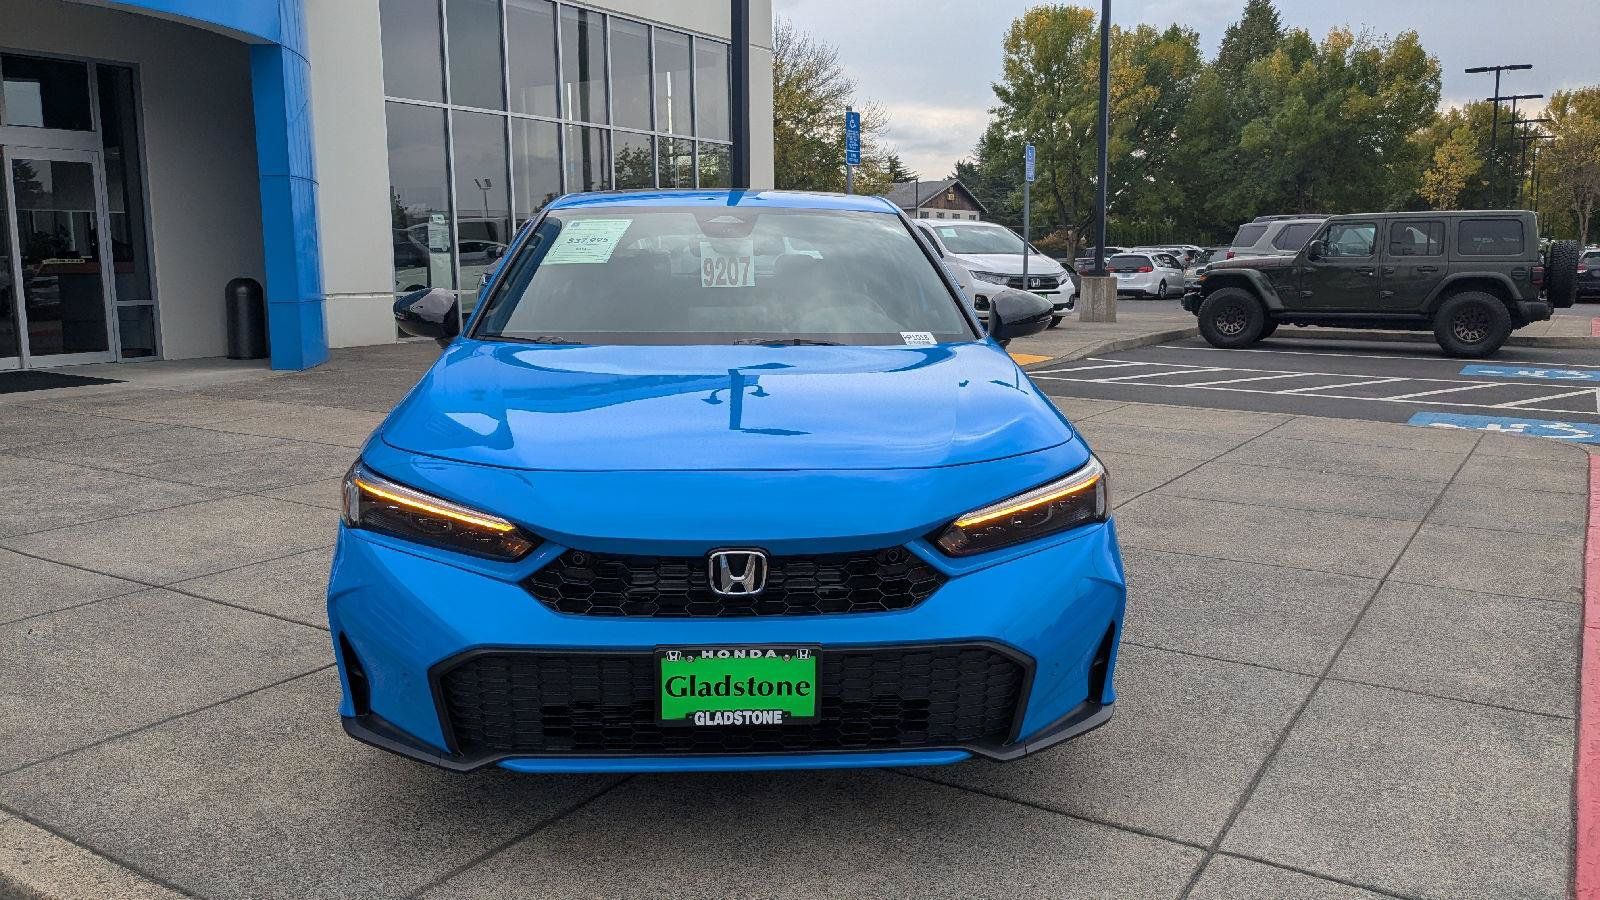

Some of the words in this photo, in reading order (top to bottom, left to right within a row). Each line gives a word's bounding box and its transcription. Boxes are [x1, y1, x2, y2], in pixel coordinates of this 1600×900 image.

[703, 255, 751, 286] 9207
[701, 649, 778, 659] HONDA
[664, 674, 811, 697] Gladstone
[693, 710, 783, 726] GLADSTONE
